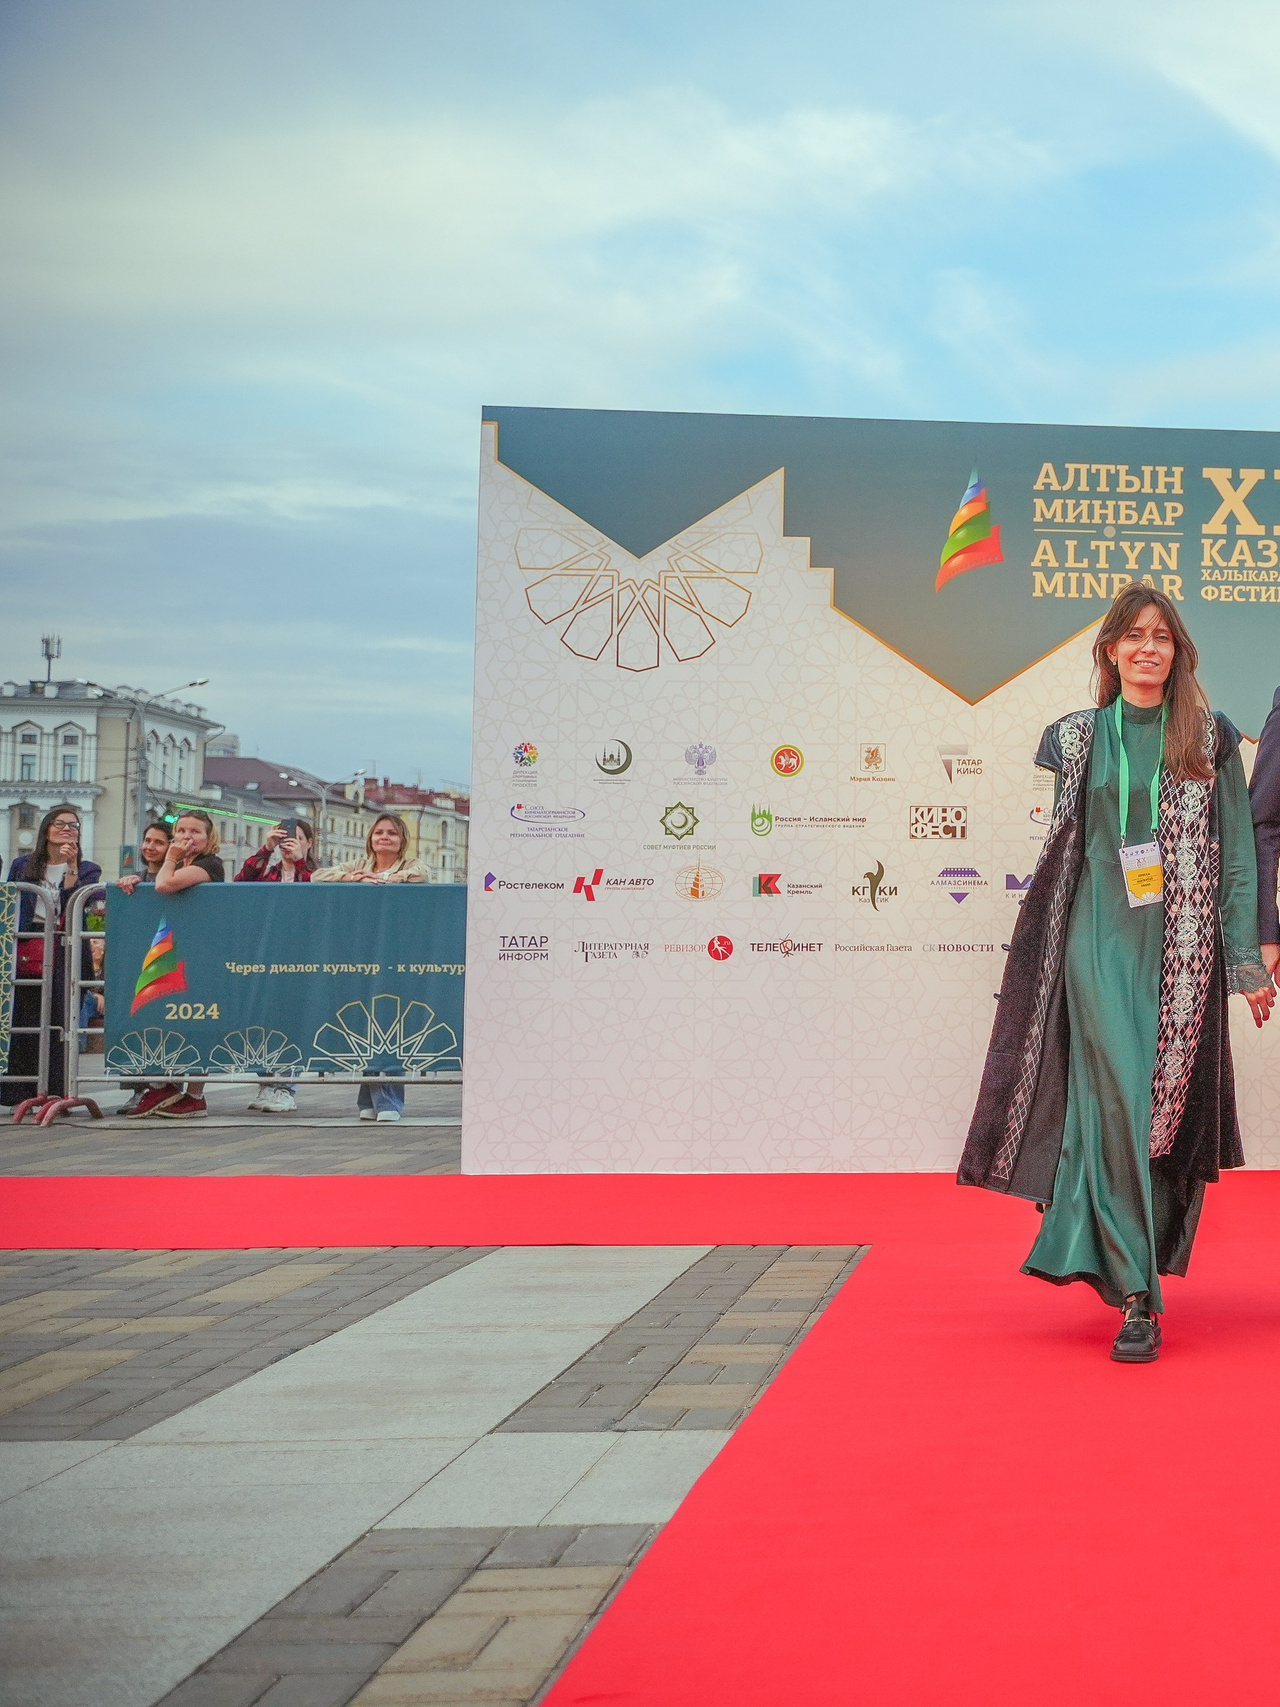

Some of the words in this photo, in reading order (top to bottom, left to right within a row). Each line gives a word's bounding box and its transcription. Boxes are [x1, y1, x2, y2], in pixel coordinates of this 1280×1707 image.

[1033, 462, 1184, 494] АЛТЫН
[1033, 498, 1184, 526] МИНБАР
[1031, 539, 1180, 570] ALTYN
[956, 767, 983, 775] КИНО
[911, 807, 967, 823] КИНО
[911, 823, 966, 839] ФЕСТ
[498, 880, 564, 890] Ростелеком
[605, 878, 626, 886] КАН
[628, 878, 654, 886] АВТО
[499, 936, 549, 947] ТАТАР
[664, 944, 706, 952] РЕВИЗОР
[834, 943, 885, 952] Российская
[886, 943, 912, 952] Газета
[226, 962, 266, 975] Через
[269, 962, 319, 974] диалог
[323, 963, 380, 975] культур
[397, 964, 406, 973] к
[165, 1003, 220, 1020] 2024
